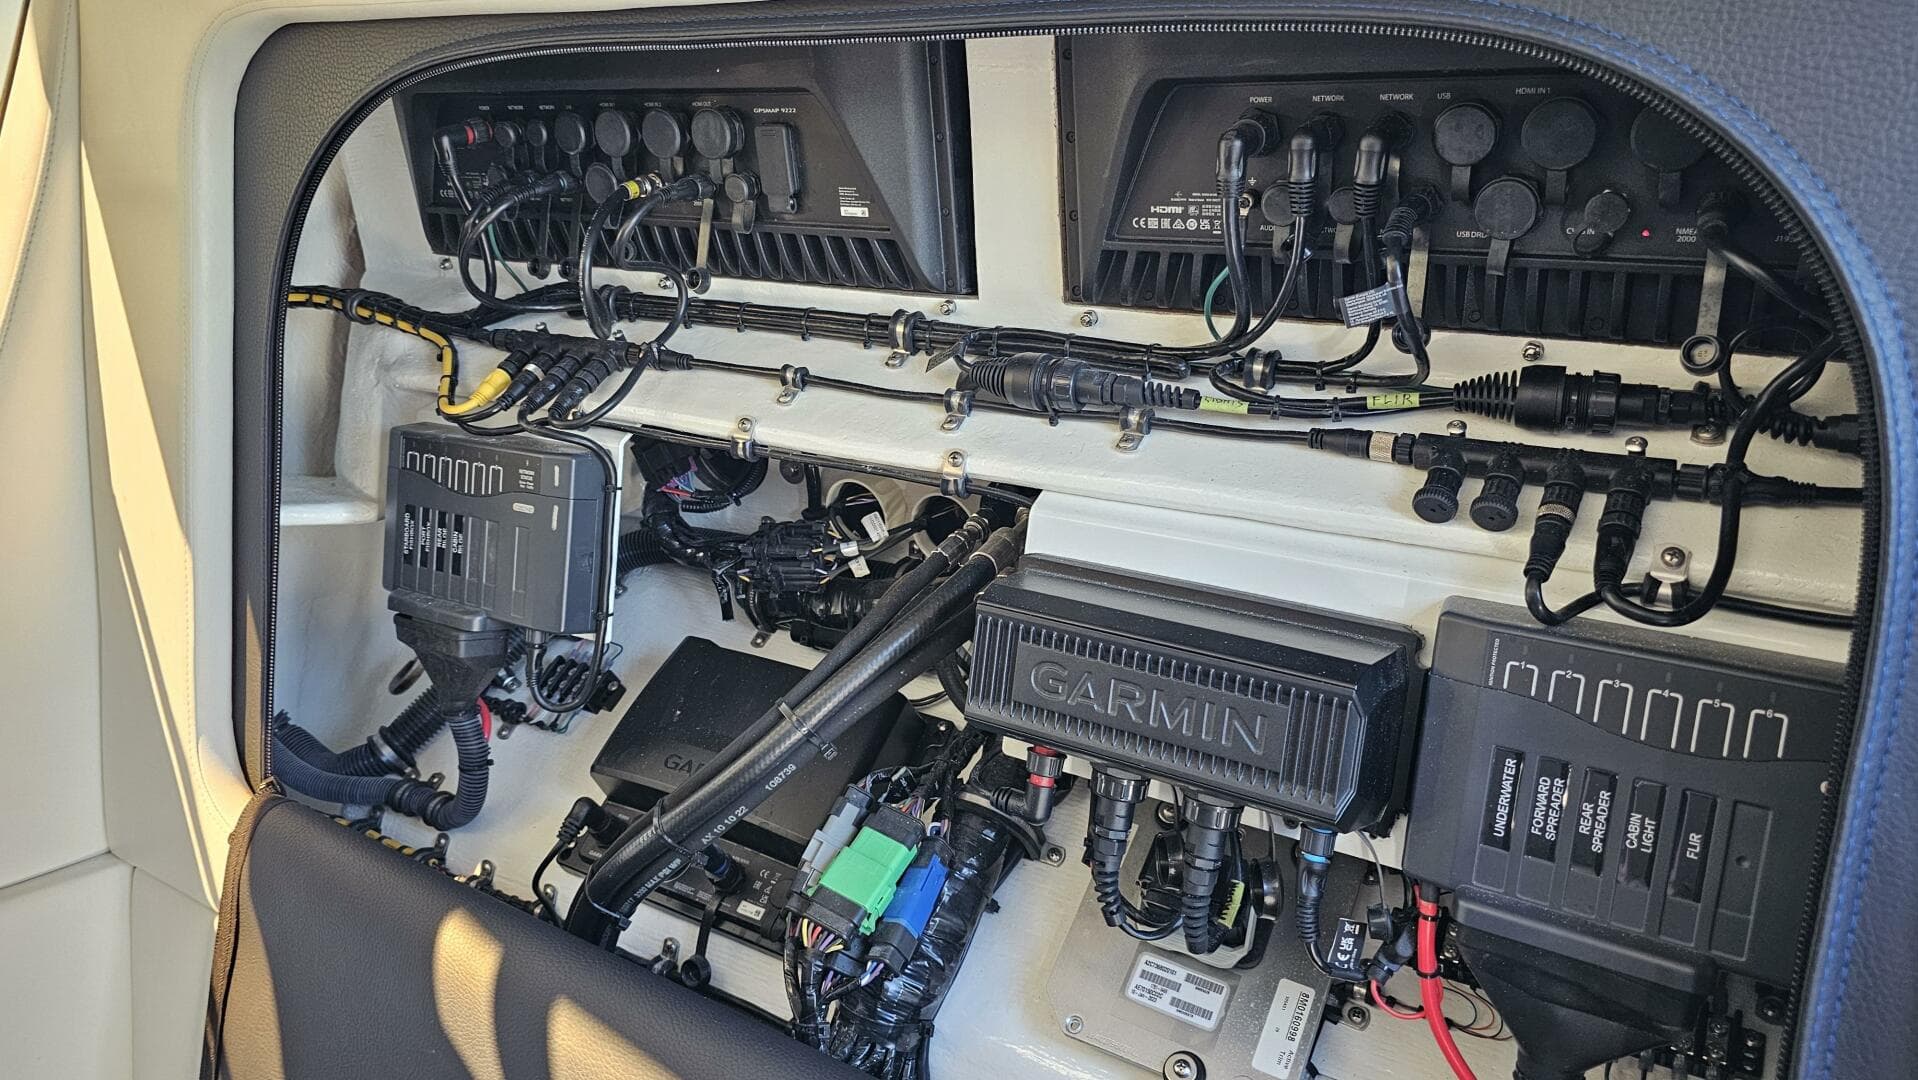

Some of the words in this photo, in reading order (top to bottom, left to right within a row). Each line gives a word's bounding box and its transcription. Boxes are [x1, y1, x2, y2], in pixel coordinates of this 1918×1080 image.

[1515, 87, 1536, 95] HDMI
[1372, 394, 1414, 407] FLIR
[1520, 661, 1525, 670] 1
[1566, 670, 1572, 678] 2
[1613, 680, 1620, 688] 3
[1663, 689, 1670, 698] 4
[1030, 661, 1268, 755] GARMIN
[1713, 699, 1720, 707] 5
[1766, 709, 1773, 718] 6
[714, 824, 726, 834] 10
[724, 815, 737, 824] 10
[735, 806, 748, 817] 22
[765, 764, 797, 791] 108739
[1493, 758, 1517, 838] UNDERWATER
[1531, 776, 1551, 836] FORWARD
[1545, 778, 1566, 841] SPREADER
[1579, 802, 1594, 835] REAR
[1592, 790, 1612, 853] SPREADER
[1626, 813, 1642, 849] CABIN
[1641, 818, 1657, 854] LIGHT
[1687, 832, 1702, 860] FLIR
[1288, 992, 1309, 1042] 8M0160998
